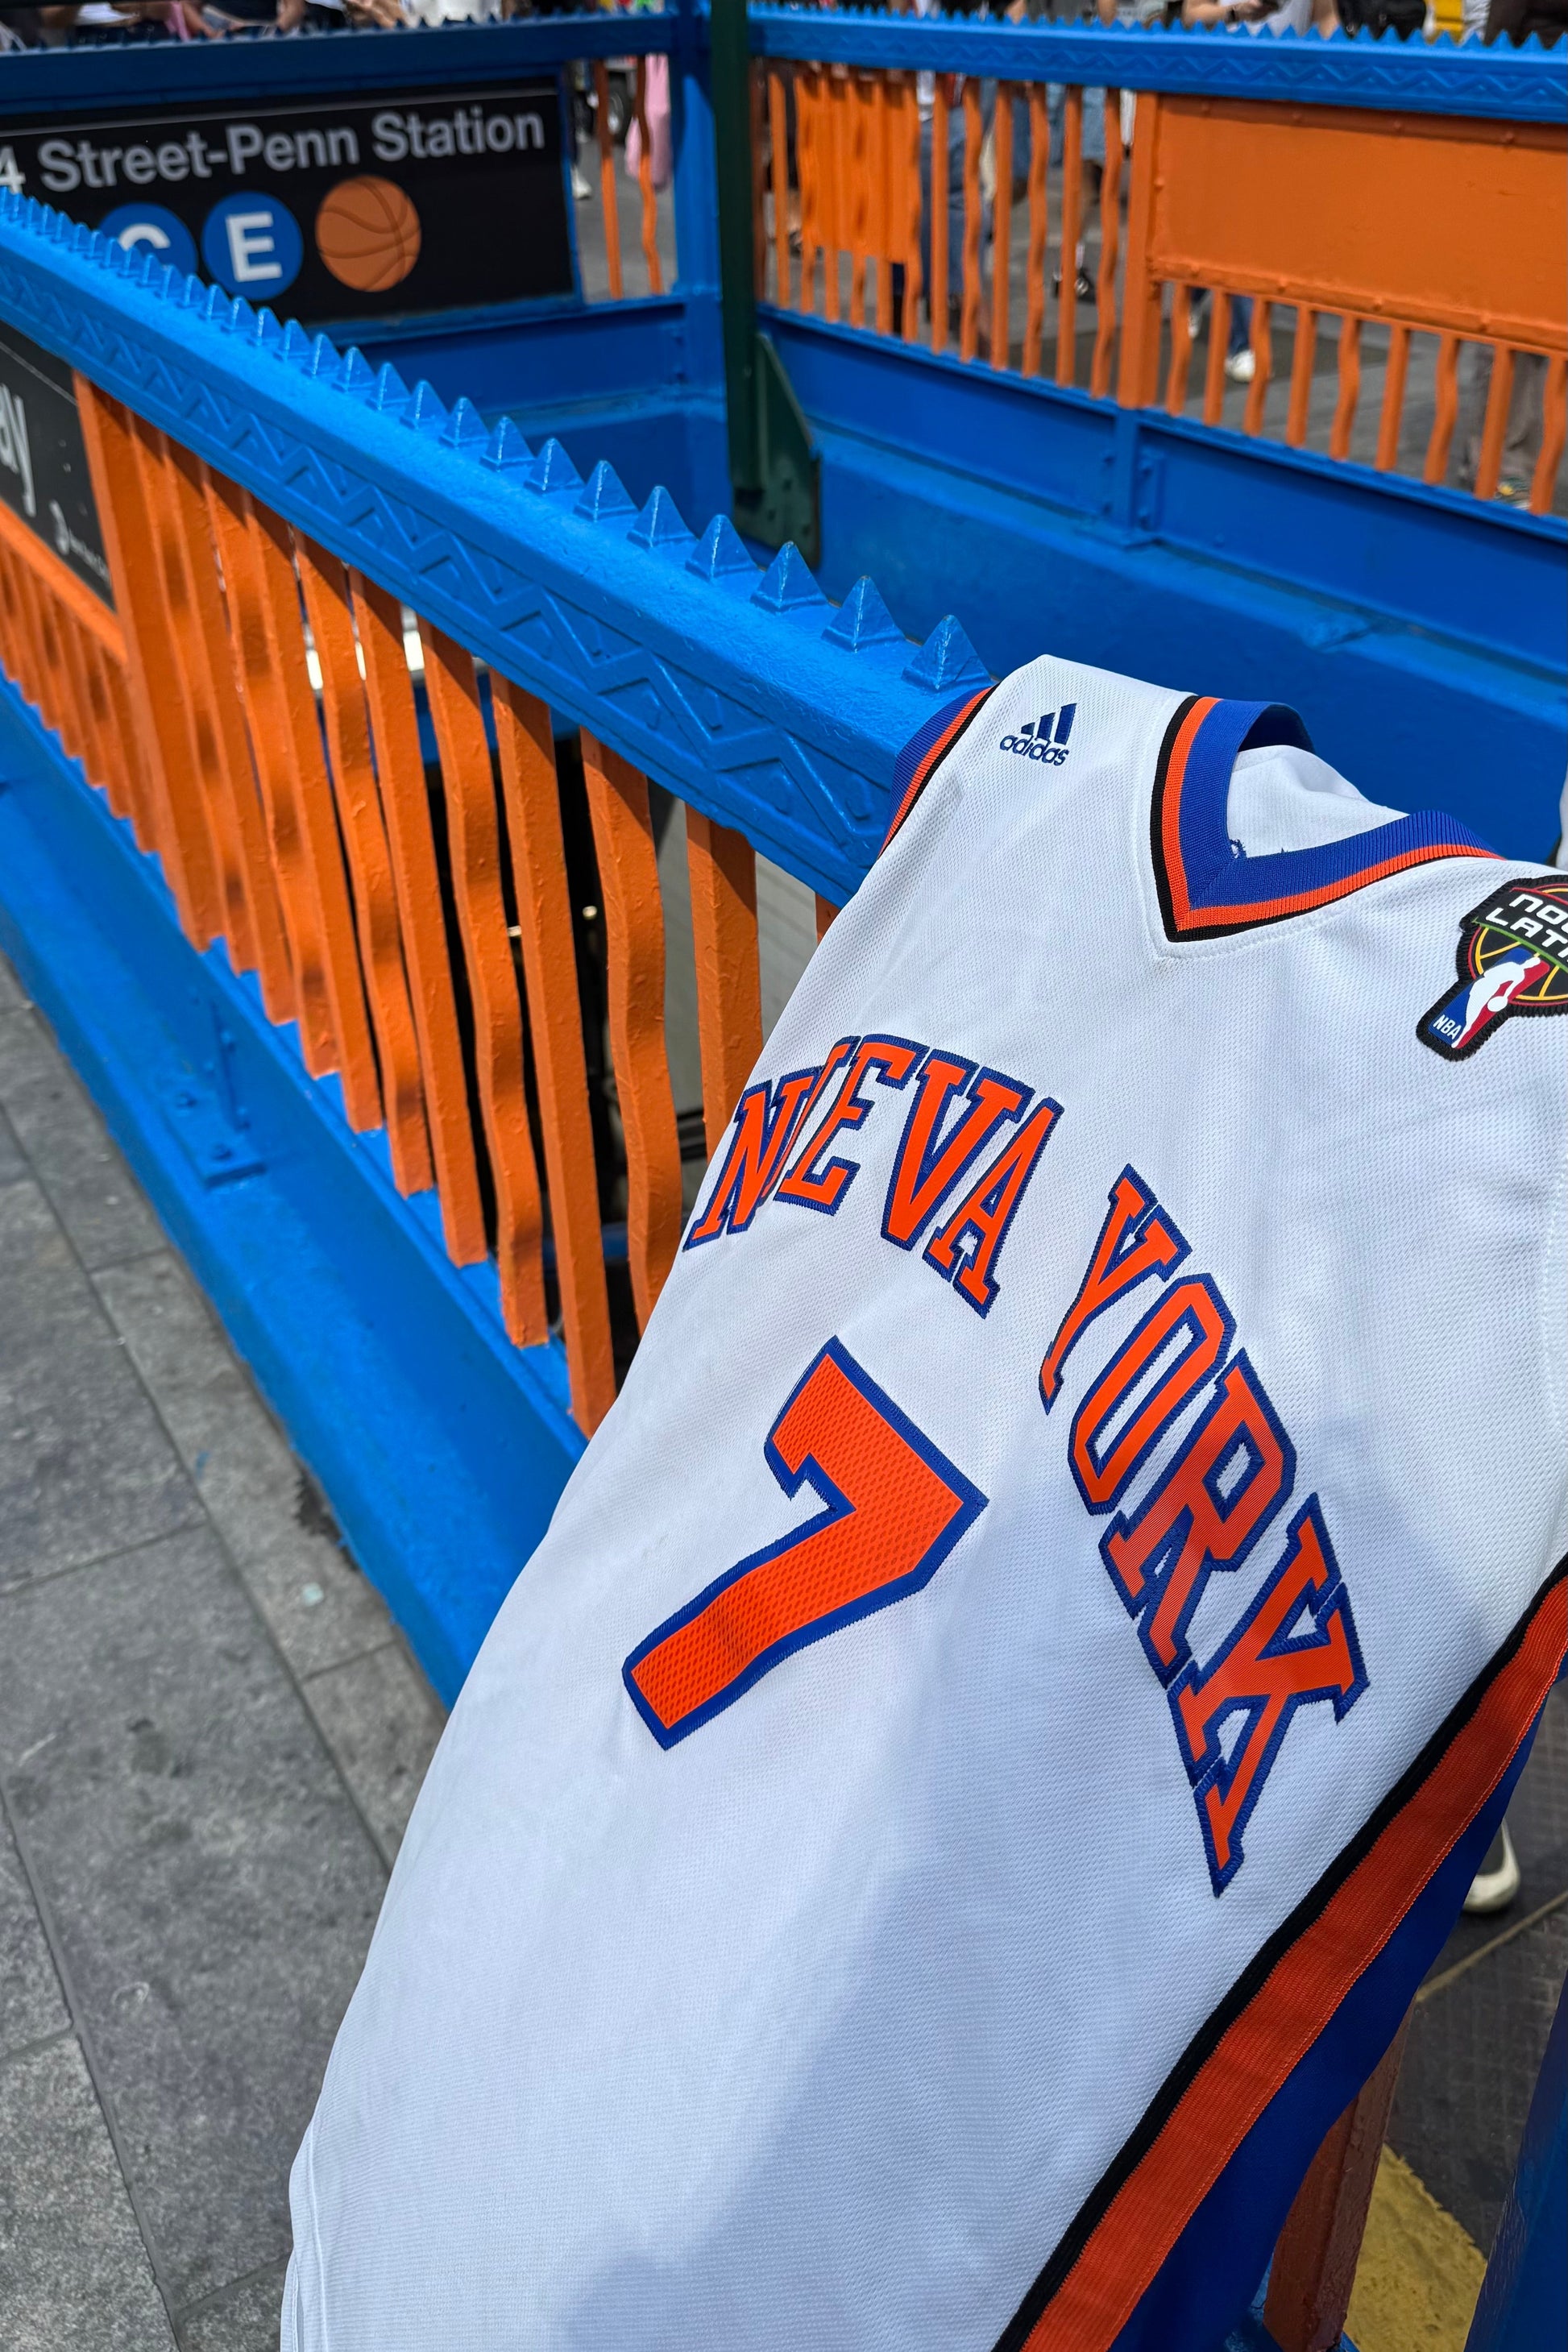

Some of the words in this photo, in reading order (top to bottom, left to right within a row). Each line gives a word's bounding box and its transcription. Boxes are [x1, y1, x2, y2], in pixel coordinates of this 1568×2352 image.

[38, 123, 360, 193] Street-Penn
[371, 106, 545, 162] Station
[226, 211, 283, 282] E
[999, 735, 1070, 766] adidas
[1508, 894, 1568, 934] NO
[1433, 1014, 1463, 1040] NBA
[622, 1334, 990, 1751] 7
[1038, 1164, 1370, 1899] YORK
